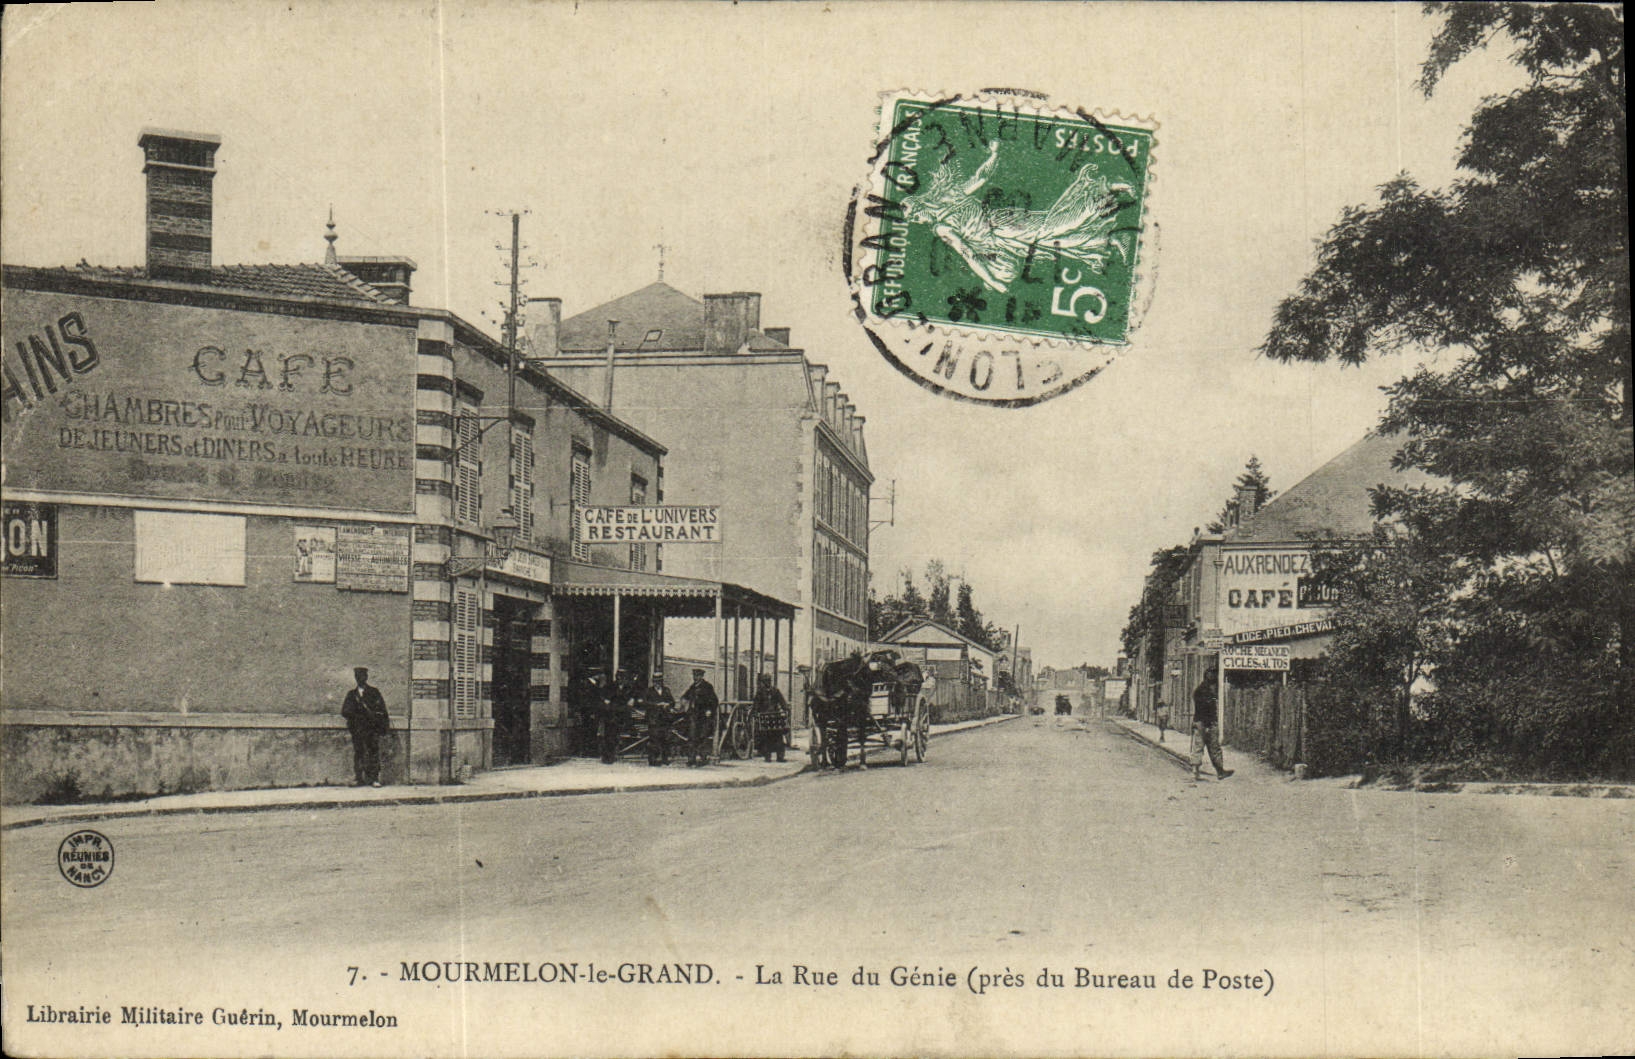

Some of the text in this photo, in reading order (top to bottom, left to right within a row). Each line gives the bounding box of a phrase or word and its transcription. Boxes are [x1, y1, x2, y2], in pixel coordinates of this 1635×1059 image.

[61, 390, 212, 429] CHAMBRES
[247, 403, 413, 443] VOYAGEURS
[200, 436, 276, 463] DINERS
[339, 446, 412, 471] HEURE
[627, 512, 639, 524] DE
[641, 508, 717, 524] L'UNIVERS
[588, 525, 714, 540] RESTAURANT
[1228, 582, 1293, 609] CAFÉ
